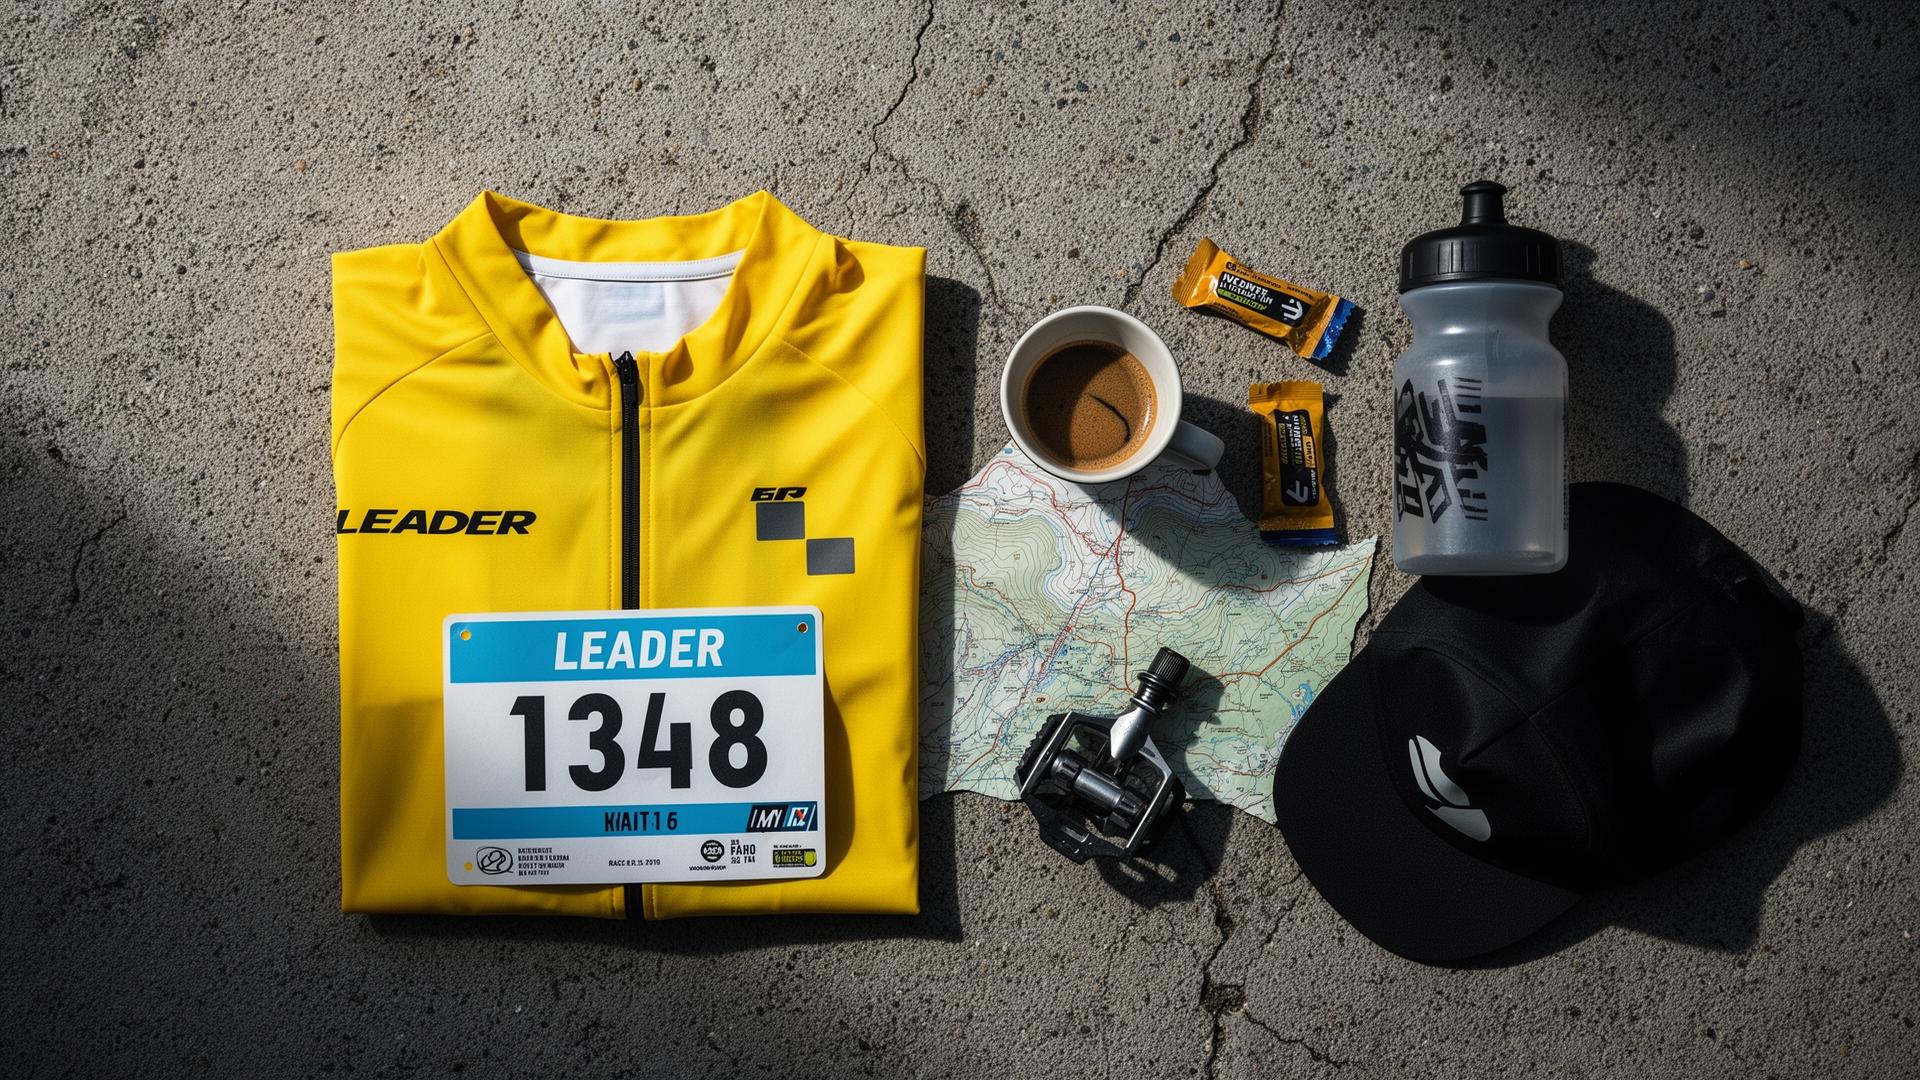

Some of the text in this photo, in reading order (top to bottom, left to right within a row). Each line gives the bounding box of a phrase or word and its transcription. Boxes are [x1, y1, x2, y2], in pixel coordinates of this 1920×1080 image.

[336, 509, 537, 535] LEADER
[554, 628, 725, 671] LEADER
[509, 689, 768, 792] 1348
